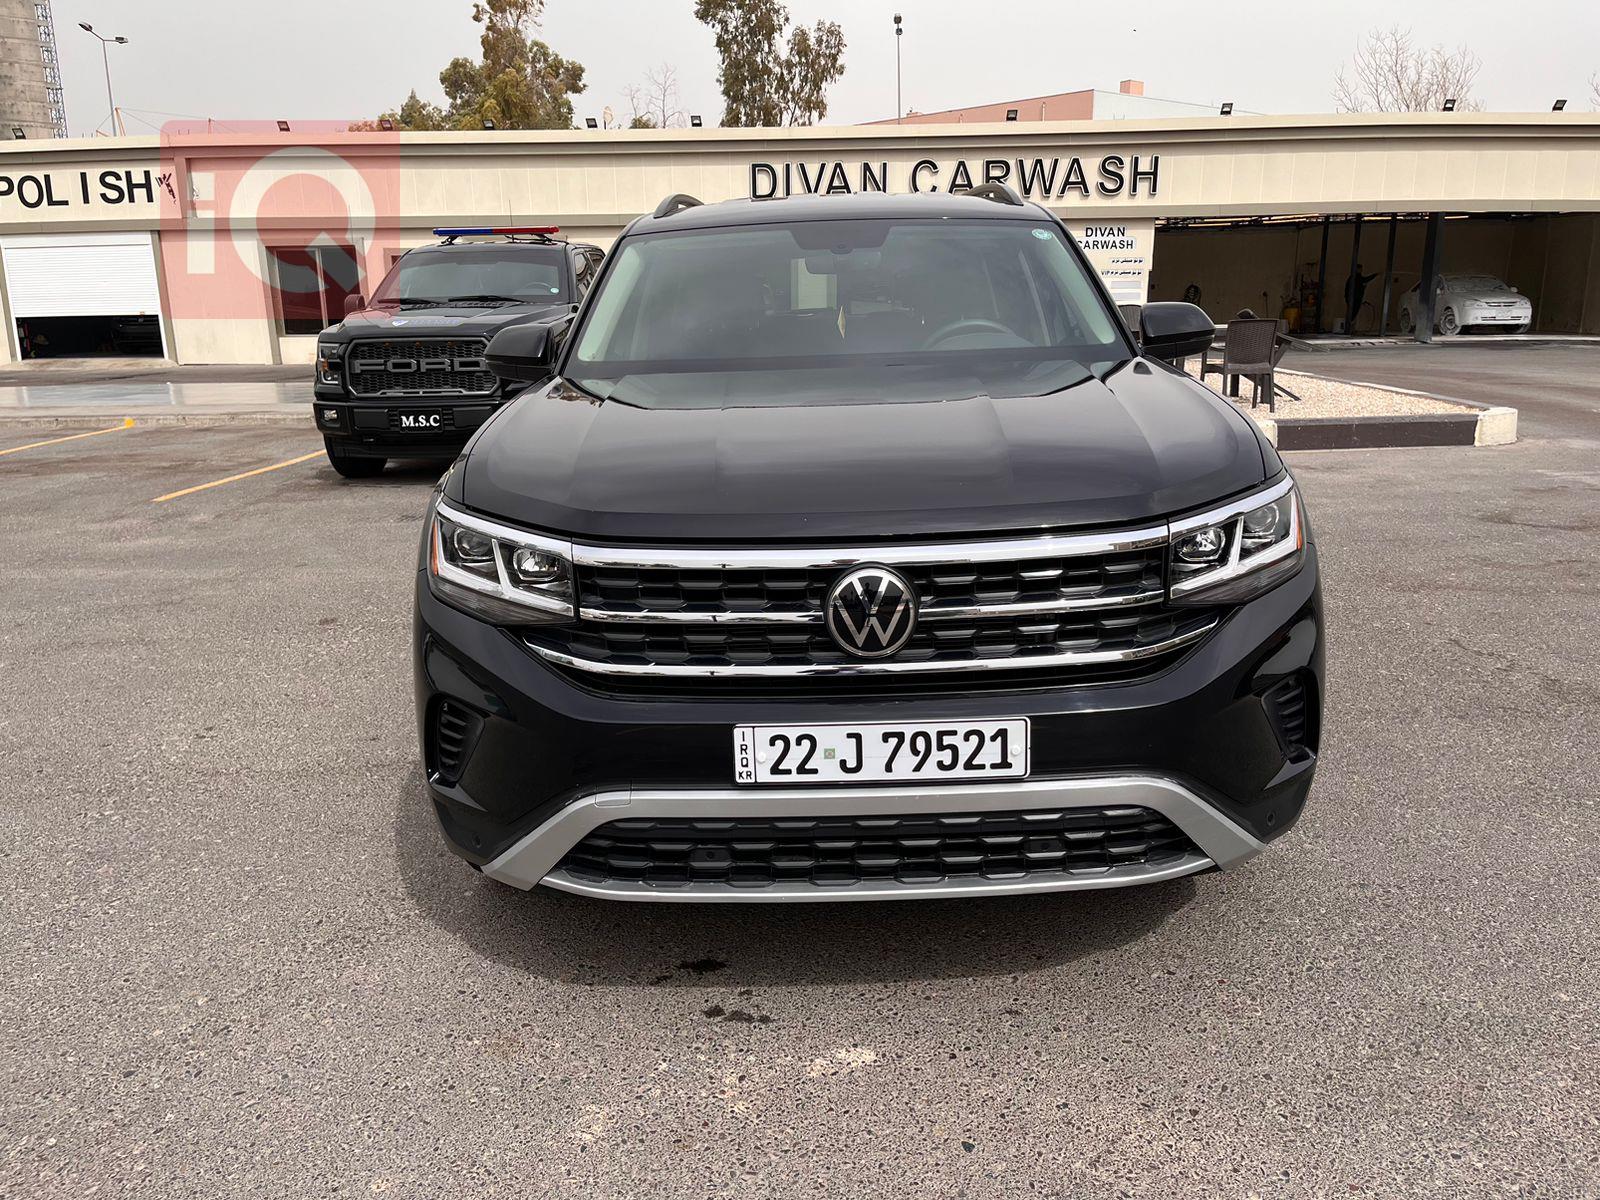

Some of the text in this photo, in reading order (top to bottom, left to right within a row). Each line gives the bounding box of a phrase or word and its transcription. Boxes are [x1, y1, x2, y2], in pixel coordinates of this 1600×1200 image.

[750, 154, 1160, 199] DIVAN CARWASH
[1085, 226, 1126, 238] DIVAN
[351, 357, 487, 374] FORD
[400, 414, 440, 428] M.S.C
[768, 727, 1013, 776] 22 J 79521
[738, 770, 752, 780] KR
